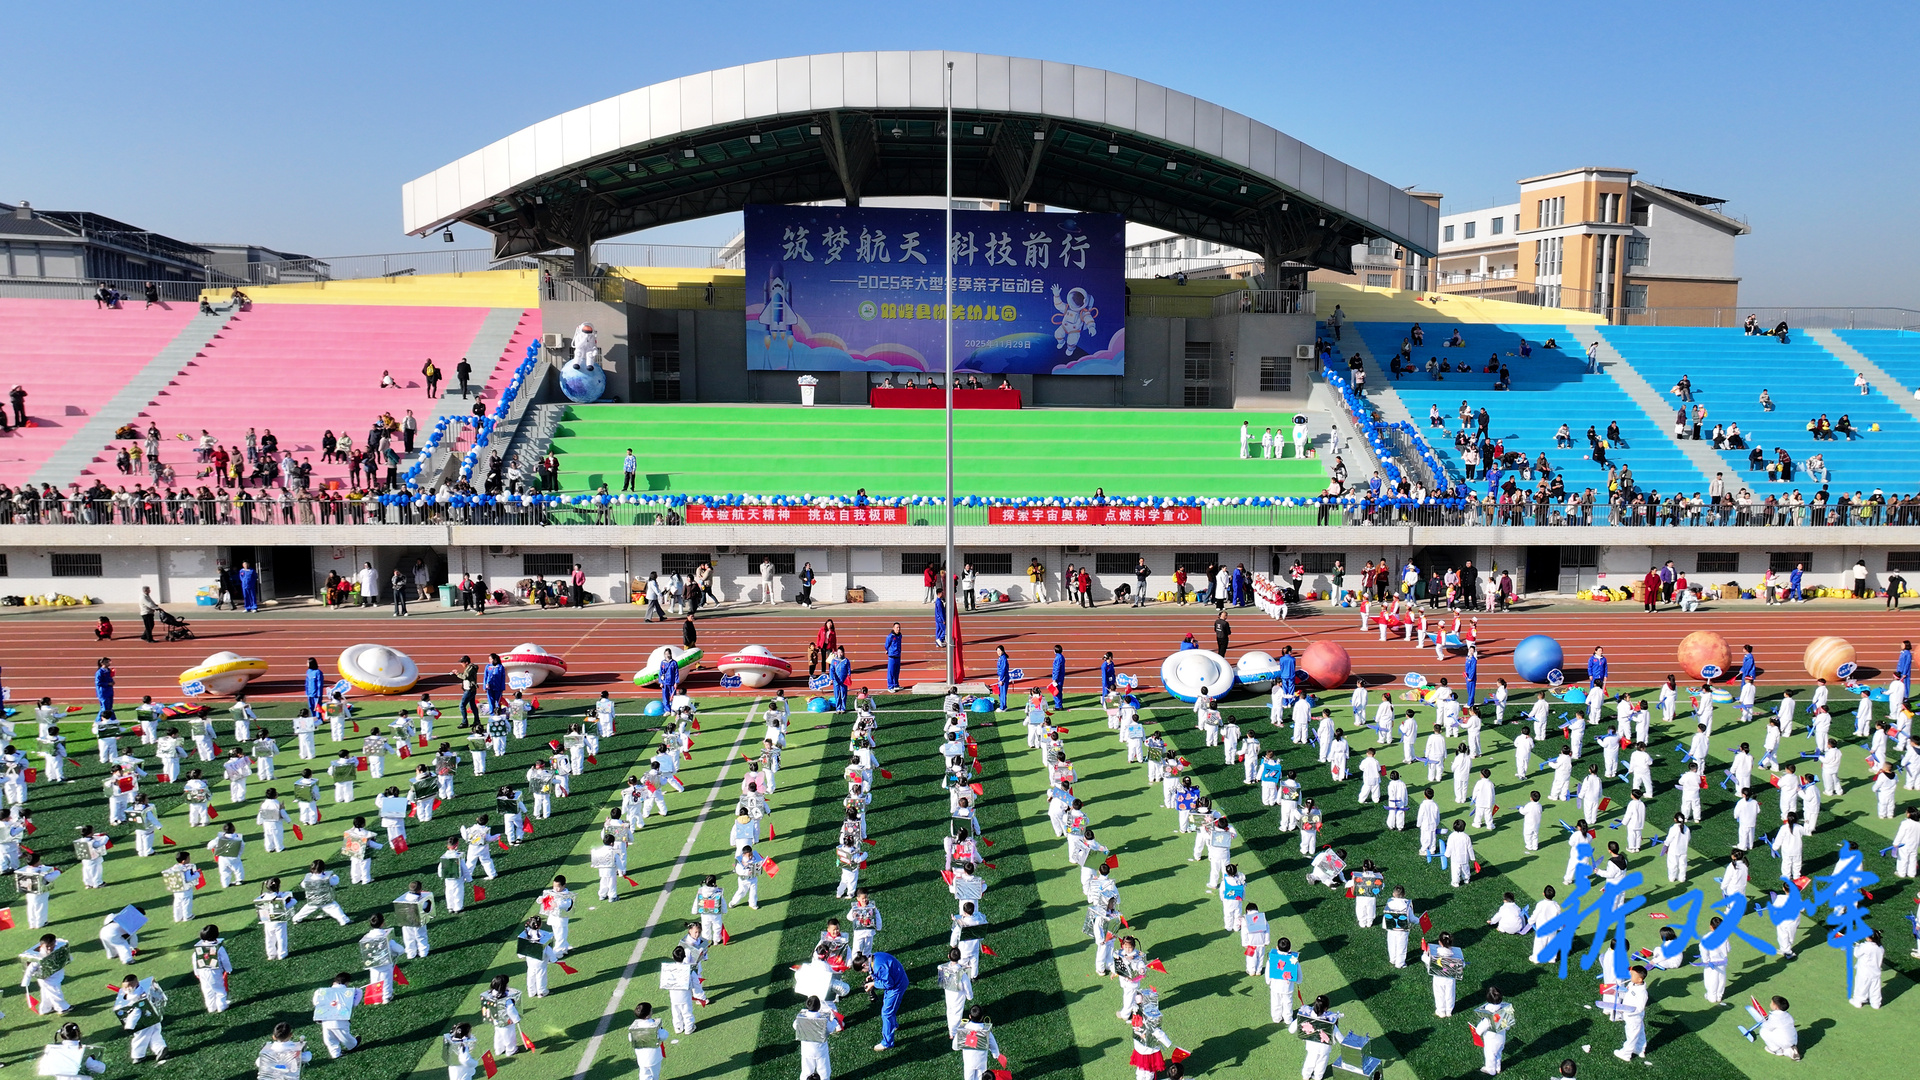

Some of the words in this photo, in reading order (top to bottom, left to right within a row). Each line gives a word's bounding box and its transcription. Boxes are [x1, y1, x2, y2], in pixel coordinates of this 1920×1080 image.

[782, 226, 928, 265] 筑梦航天
[951, 231, 1090, 270] 科技前行
[965, 339, 1031, 349] 2025年11月29日
[701, 507, 791, 522] 体验航天精神
[808, 507, 896, 522] 挑战自我极限
[1002, 508, 1088, 522] 探索宇宙奥秘
[1105, 508, 1190, 522] 点燃科学童心
